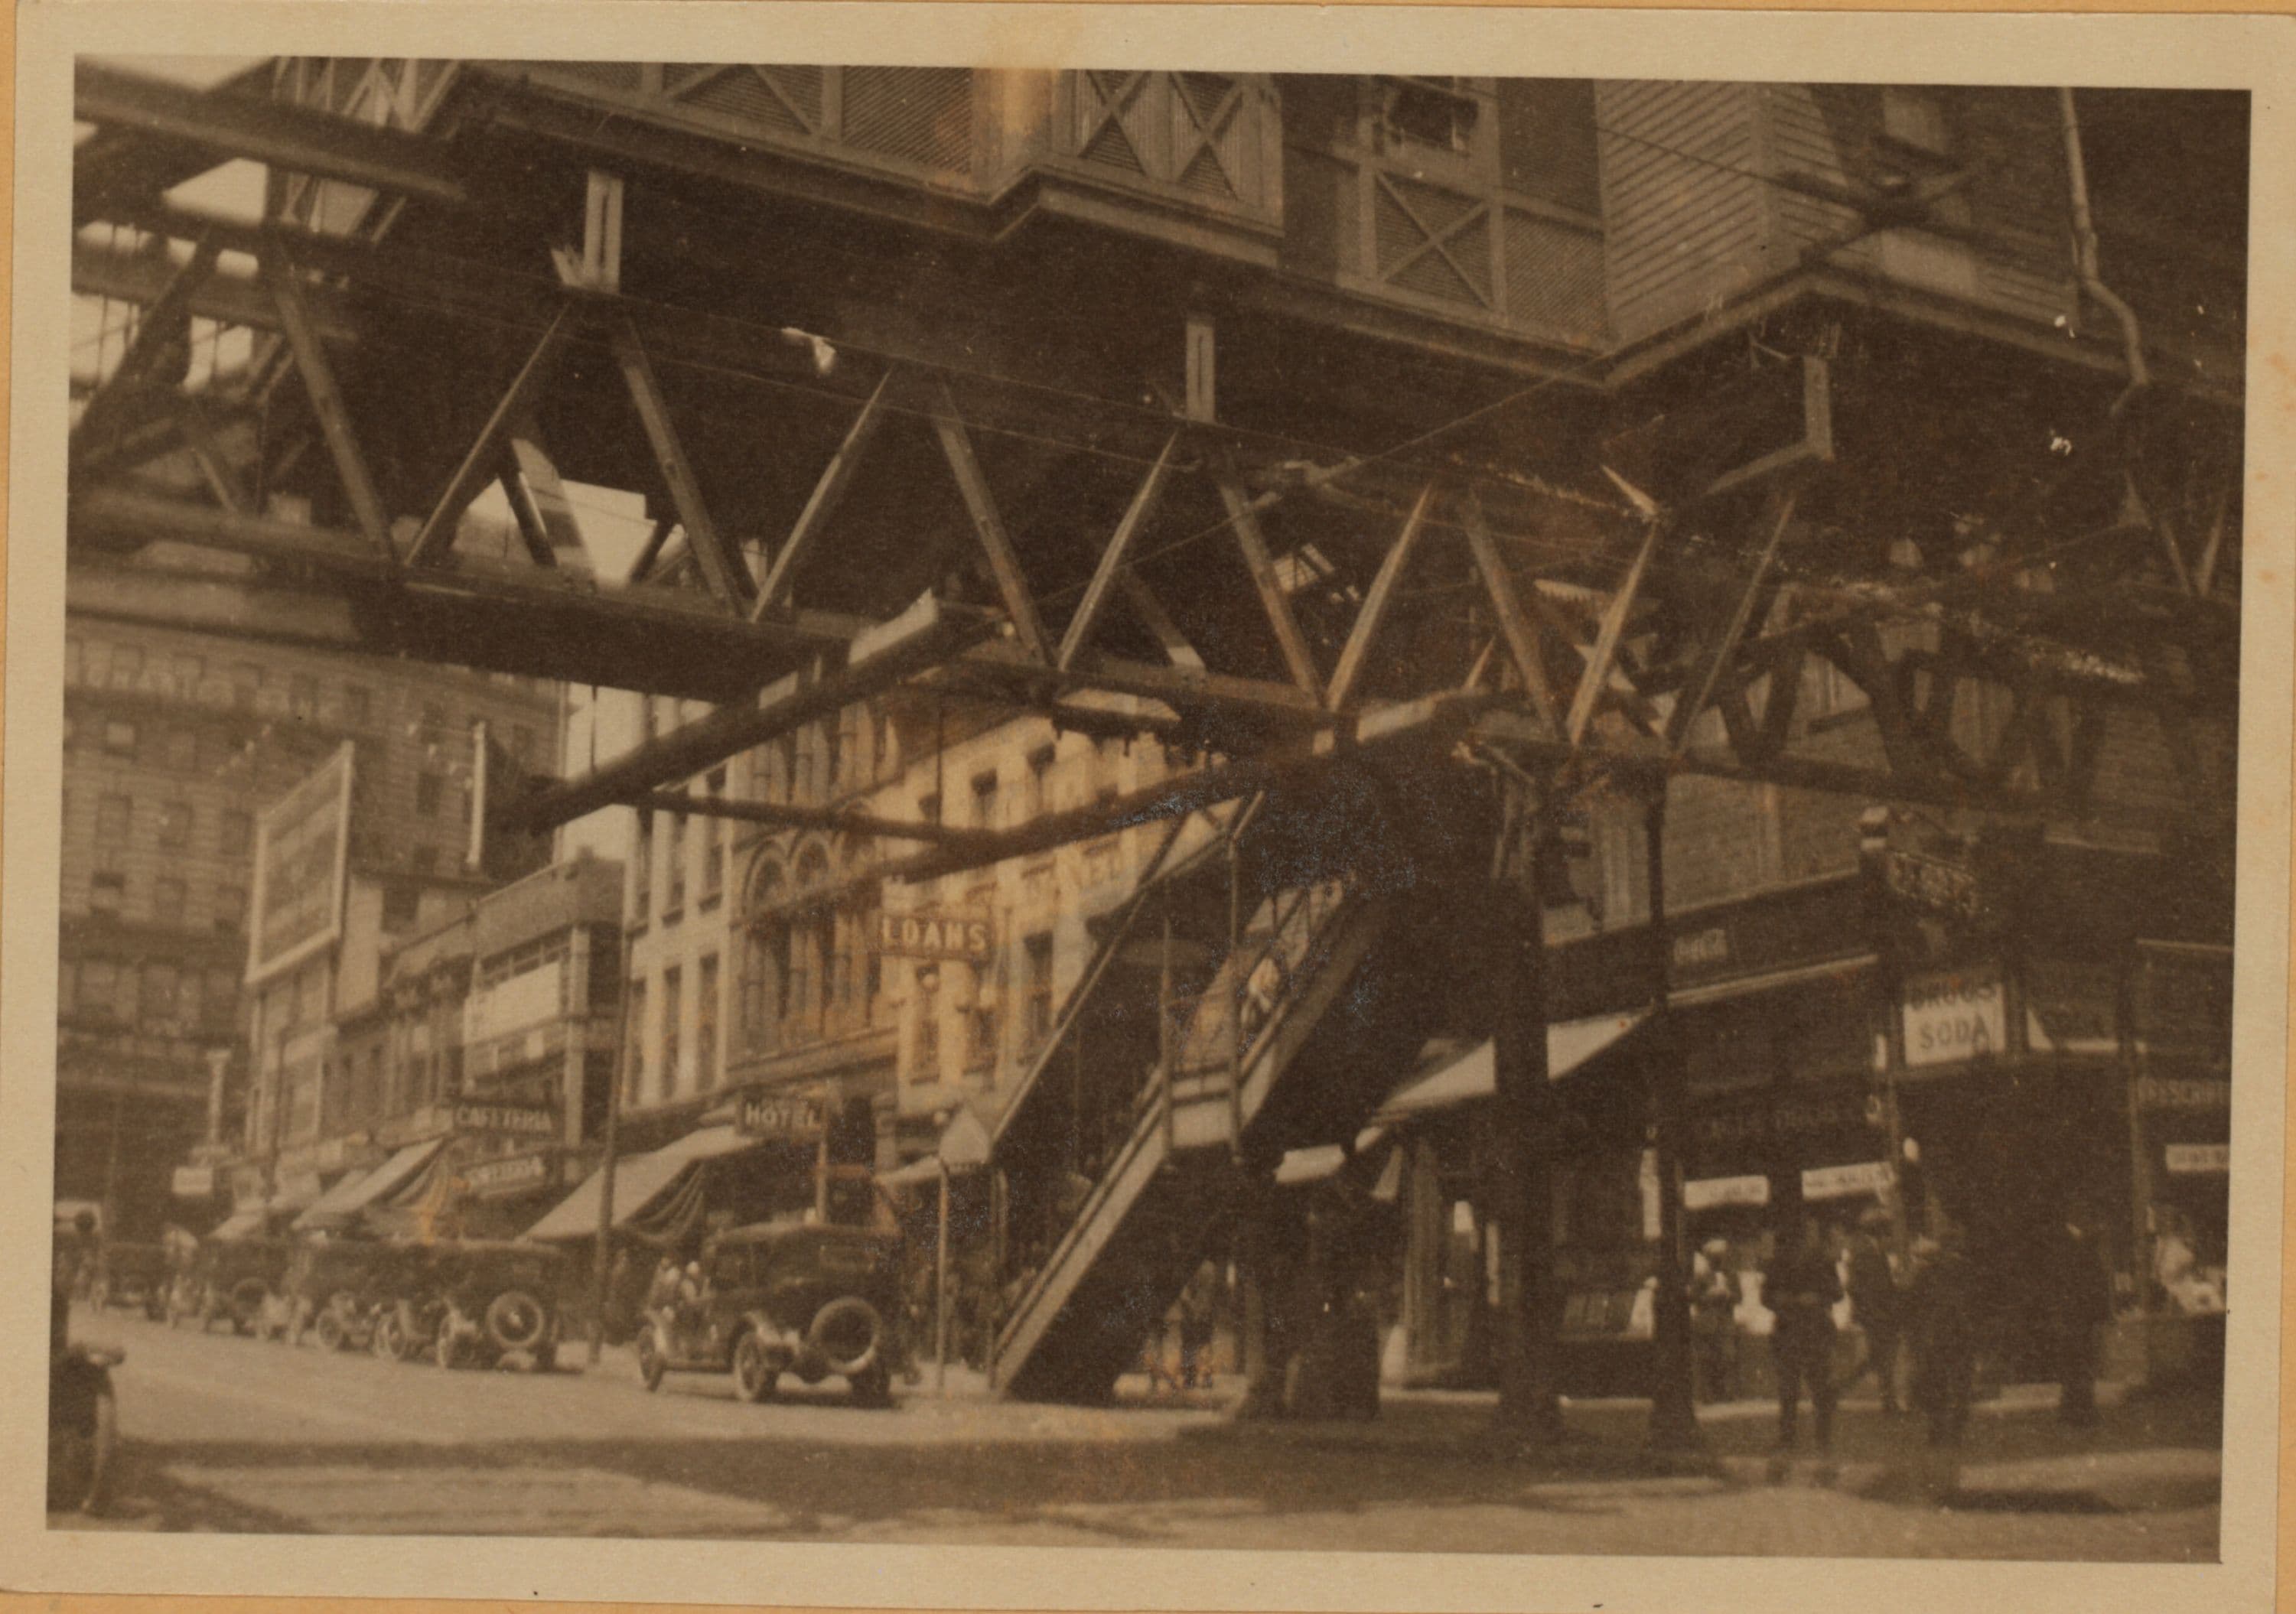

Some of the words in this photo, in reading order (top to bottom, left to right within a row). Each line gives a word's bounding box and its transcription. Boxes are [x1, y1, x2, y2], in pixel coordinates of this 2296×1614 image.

[882, 918, 986, 951] LOANS
[1918, 1013, 1991, 1052] SODA
[744, 1100, 822, 1129] HOTEL
